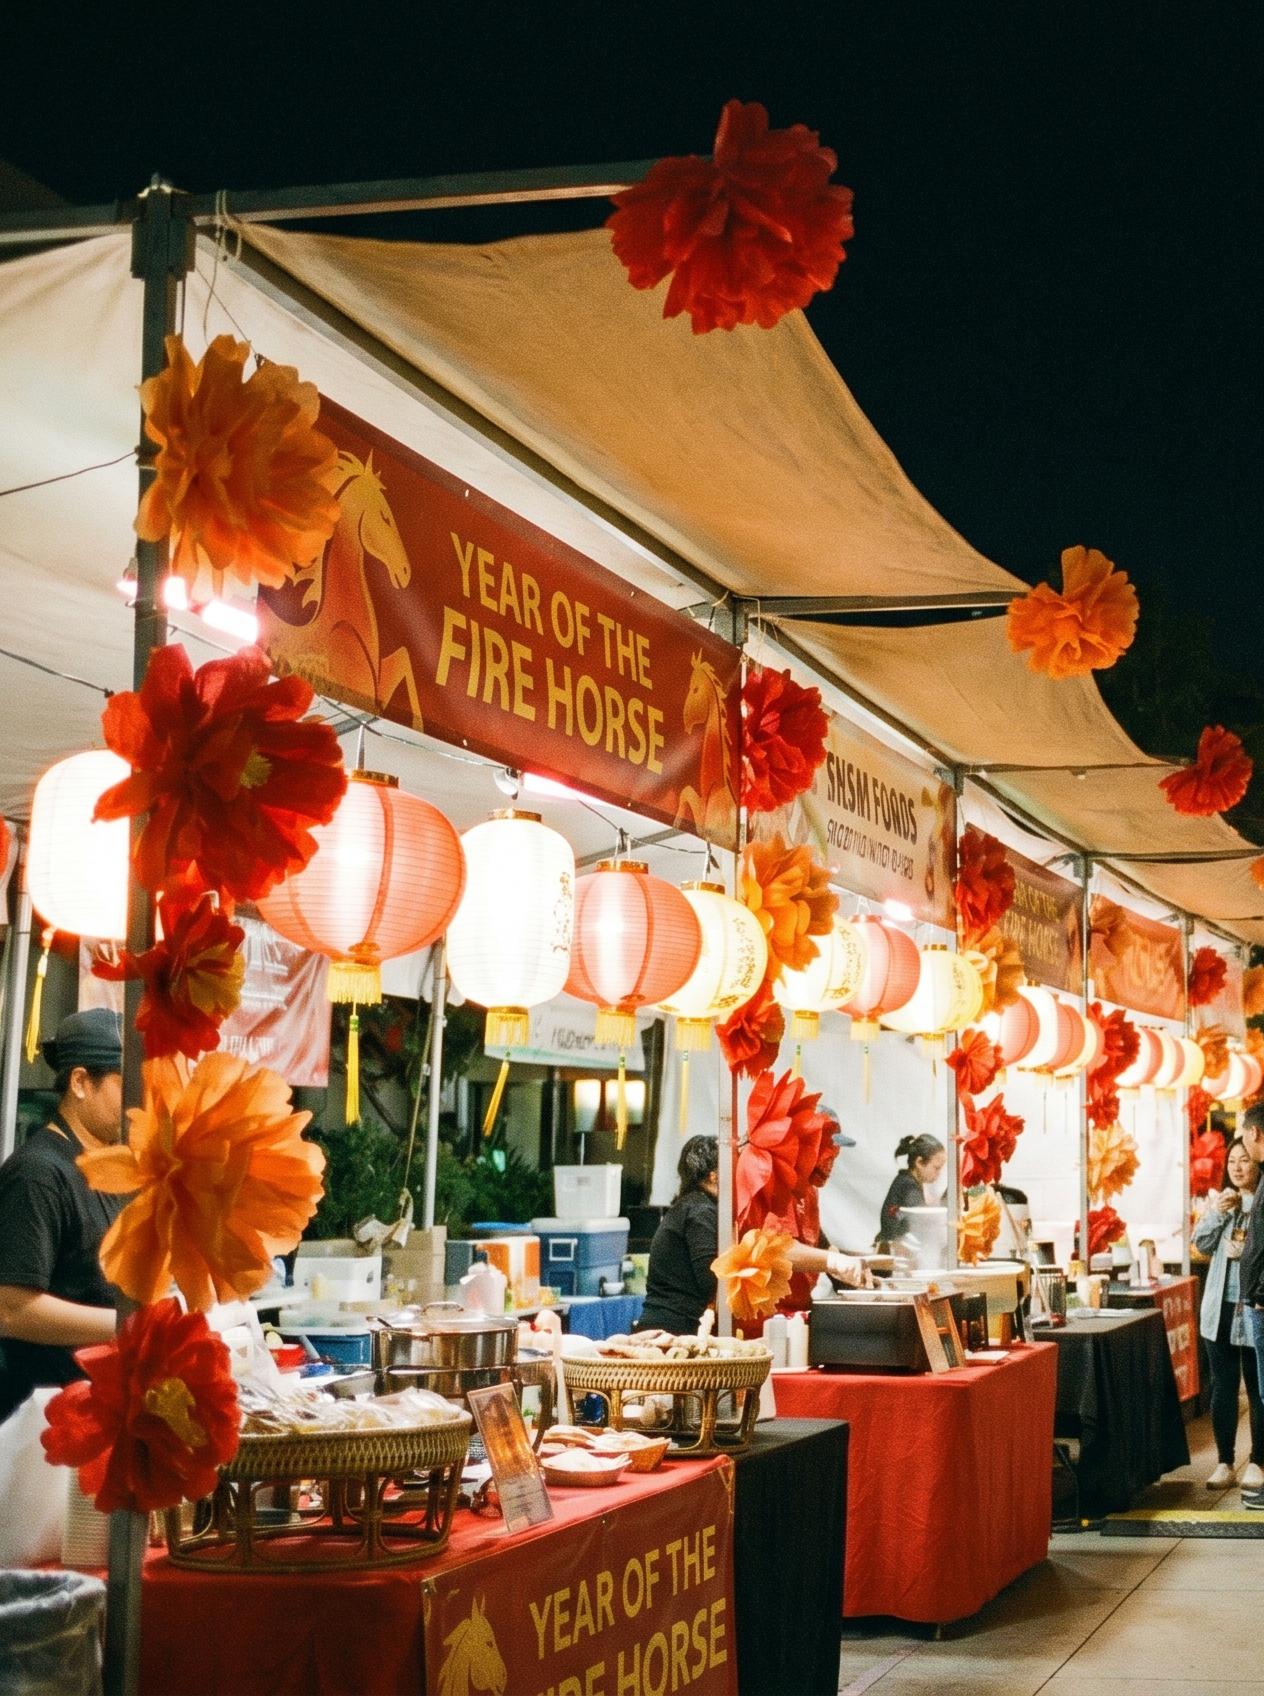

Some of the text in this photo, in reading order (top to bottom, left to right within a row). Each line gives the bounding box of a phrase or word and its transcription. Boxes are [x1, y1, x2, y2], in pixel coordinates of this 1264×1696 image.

[450, 531, 653, 690] YEAR OF THE
[435, 605, 665, 775] FIRE HORSE
[529, 1525, 716, 1660] YEAR OF THE
[617, 1597, 728, 1696] HORSE
